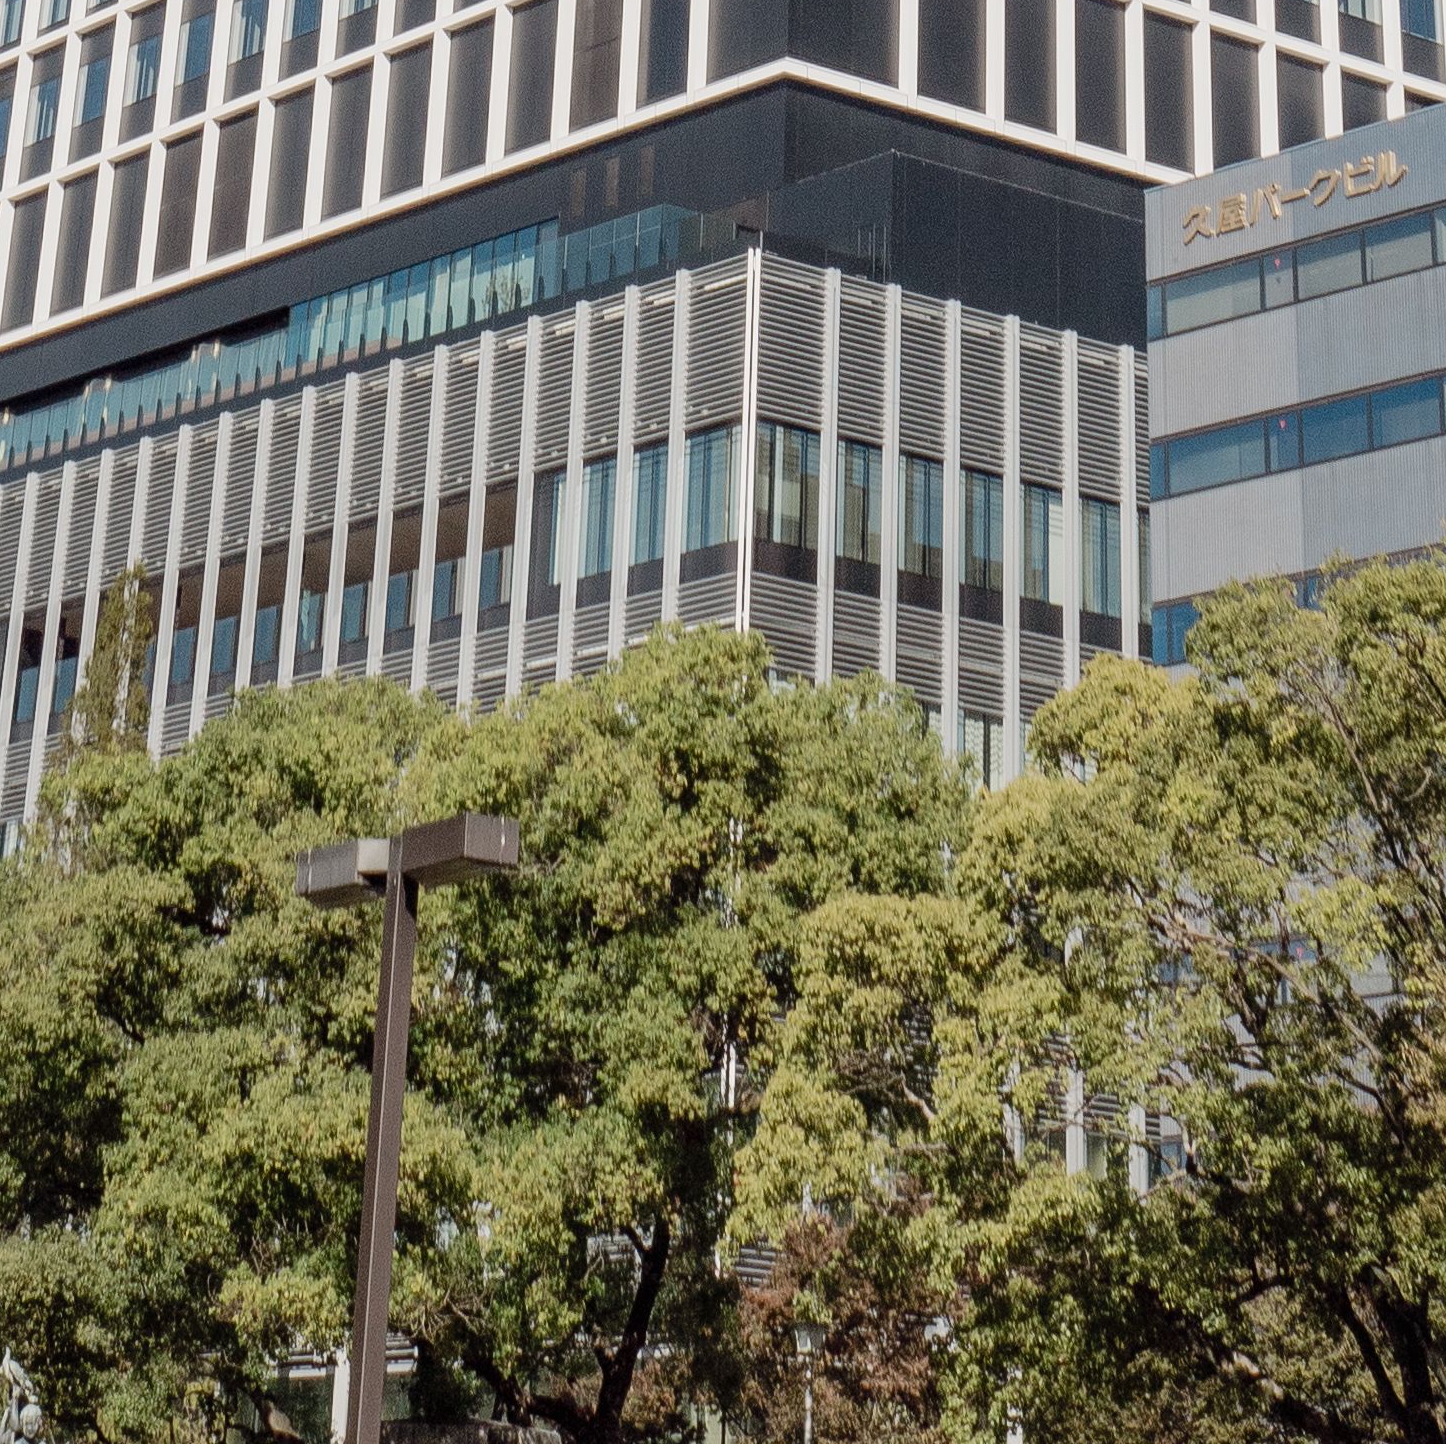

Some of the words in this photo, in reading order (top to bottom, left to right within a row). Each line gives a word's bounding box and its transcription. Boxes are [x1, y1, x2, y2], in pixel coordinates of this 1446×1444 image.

[1182, 149, 1408, 246] 久屋パークビル
